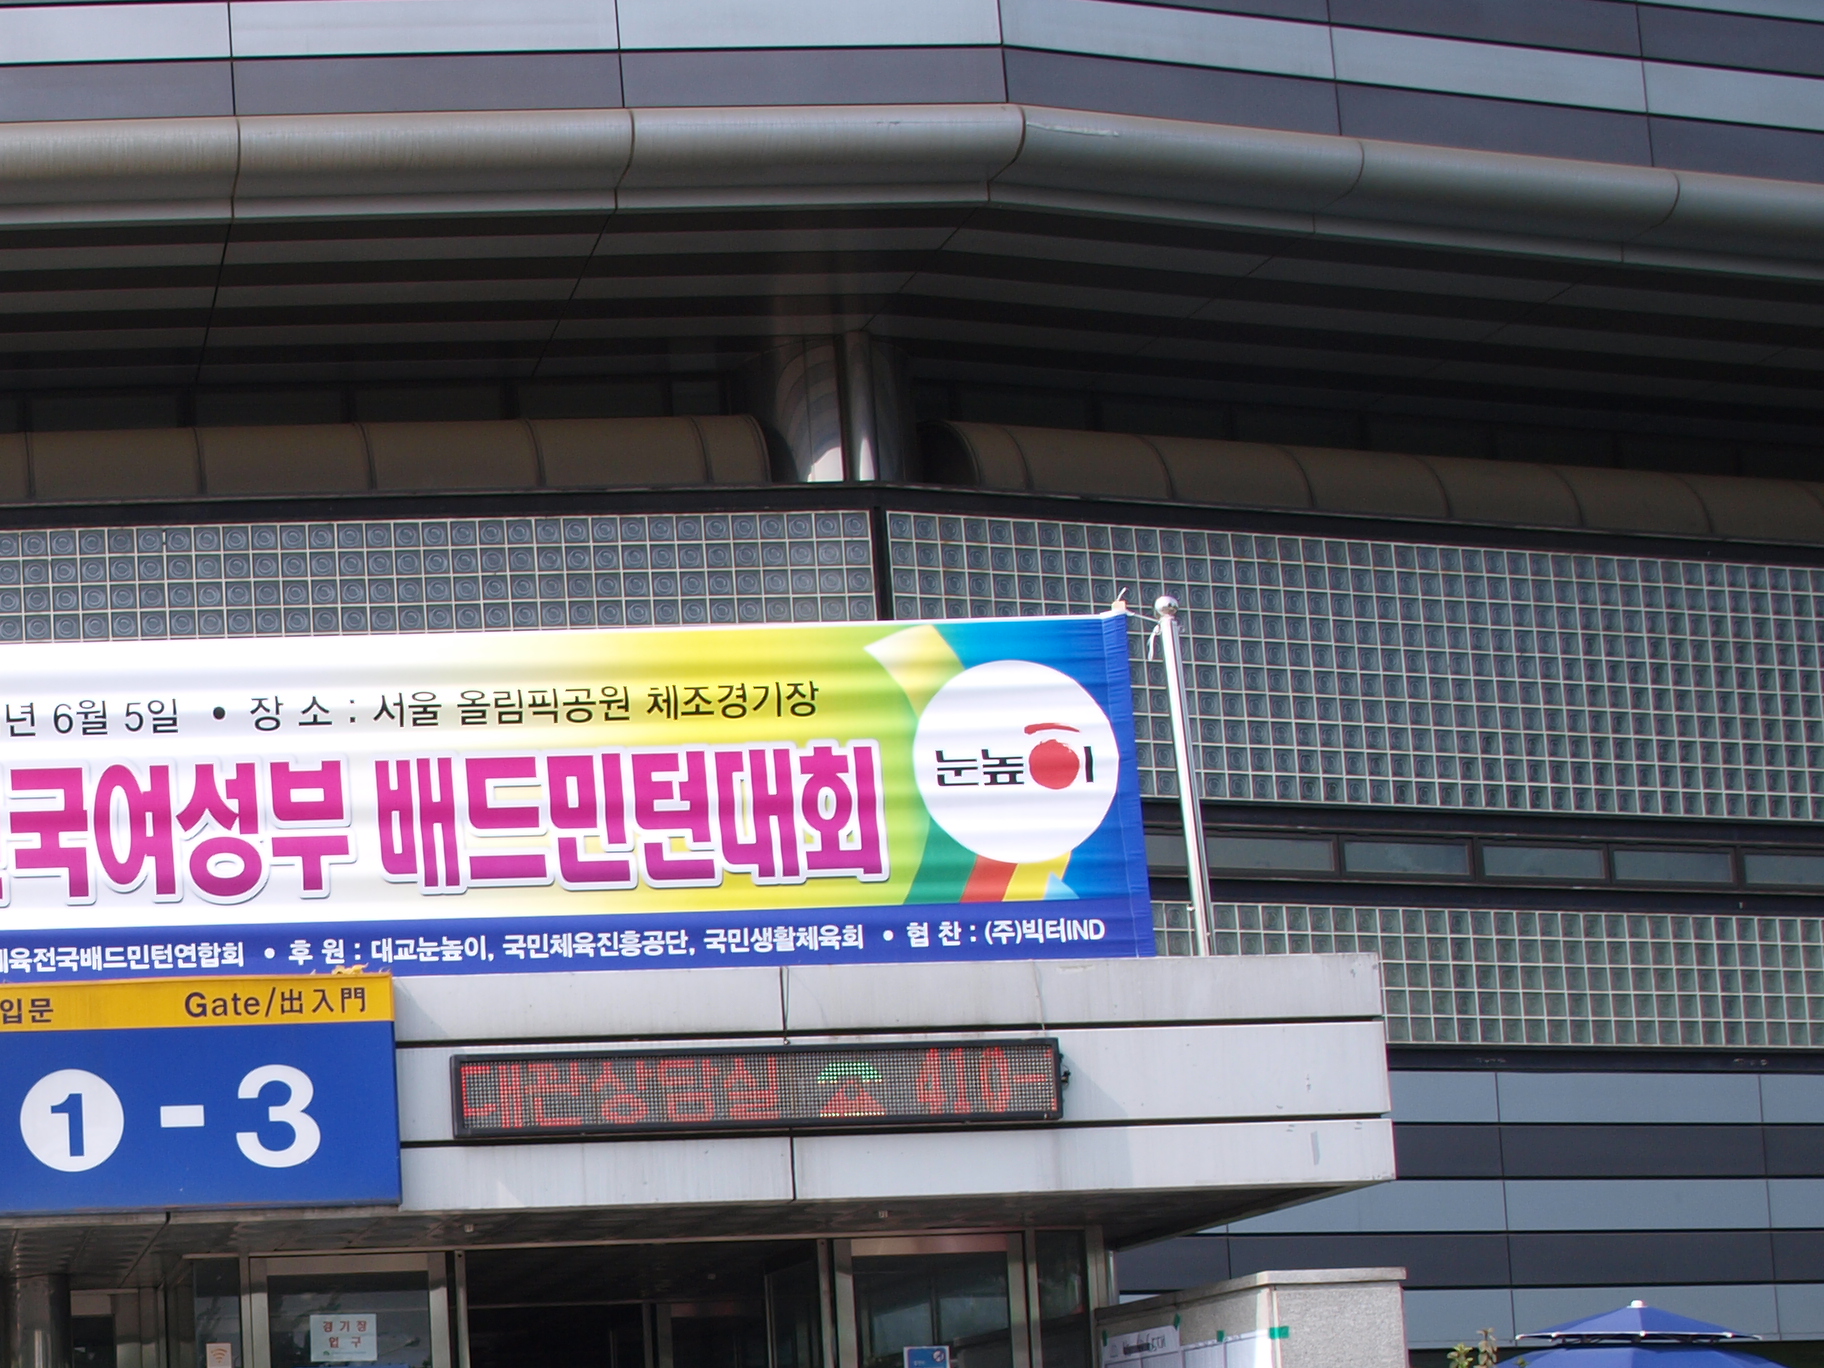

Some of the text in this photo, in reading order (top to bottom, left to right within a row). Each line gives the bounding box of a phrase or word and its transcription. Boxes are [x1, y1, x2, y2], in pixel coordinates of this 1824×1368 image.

[53, 699, 109, 736] 6월
[124, 698, 179, 735] 5일
[374, 690, 443, 728] 서울
[456, 686, 632, 727] 올림픽공원
[645, 680, 820, 720] 체조경기장
[935, 722, 1095, 790] 눈높이
[375, 745, 883, 888] 배드민턴대회
[371, 933, 495, 964] 대교눈높이,
[502, 928, 695, 959] 국민체육진흥공단,
[703, 923, 865, 954] 국민생활체육회
[984, 917, 1106, 945] (주)빅터IND
[460, 1046, 1058, 1129] 대관상담실 410-
